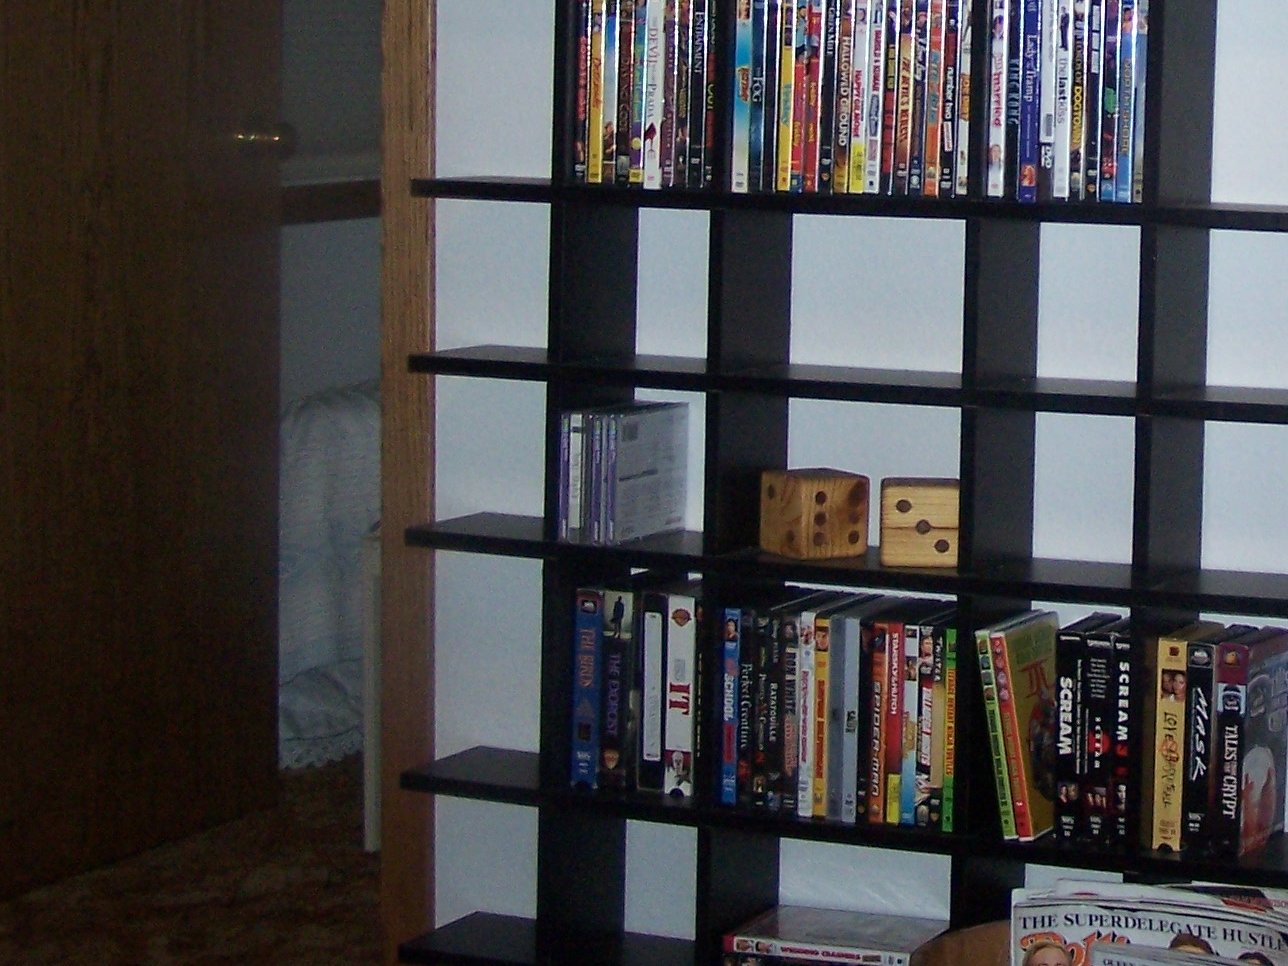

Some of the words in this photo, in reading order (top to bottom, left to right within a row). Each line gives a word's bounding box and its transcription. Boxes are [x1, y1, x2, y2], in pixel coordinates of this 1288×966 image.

[838, 36, 850, 96] HALLOWED
[1025, 34, 1037, 58] Lady
[752, 76, 763, 102] FOG
[853, 70, 862, 98] HAPPY
[945, 66, 954, 101] number
[1008, 58, 1019, 87] KING
[1023, 70, 1036, 102] Tramp
[1121, 58, 1132, 106] NORTH
[944, 102, 953, 120] two
[993, 72, 1003, 127] married
[1007, 92, 1019, 125] KONG
[1071, 85, 1082, 144] DOGTOWN
[837, 97, 849, 146] GROUND
[1043, 145, 1053, 169] DVD
[933, 636, 943, 682] TWISTER
[669, 681, 691, 716] IT
[723, 672, 734, 722] SCHOOL
[740, 663, 753, 699] Perfect
[1115, 660, 1130, 741] SCREAM
[769, 682, 779, 742] RATATOUILLE
[1056, 676, 1073, 755] SCREAM
[870, 680, 882, 797] SPIDER-MAN
[1190, 687, 1209, 782] MASK
[1223, 725, 1238, 761] TALES
[1220, 776, 1236, 820] CRYPT
[1020, 915, 1059, 930] THE
[1063, 913, 1218, 942] SUPERDELEGATE
